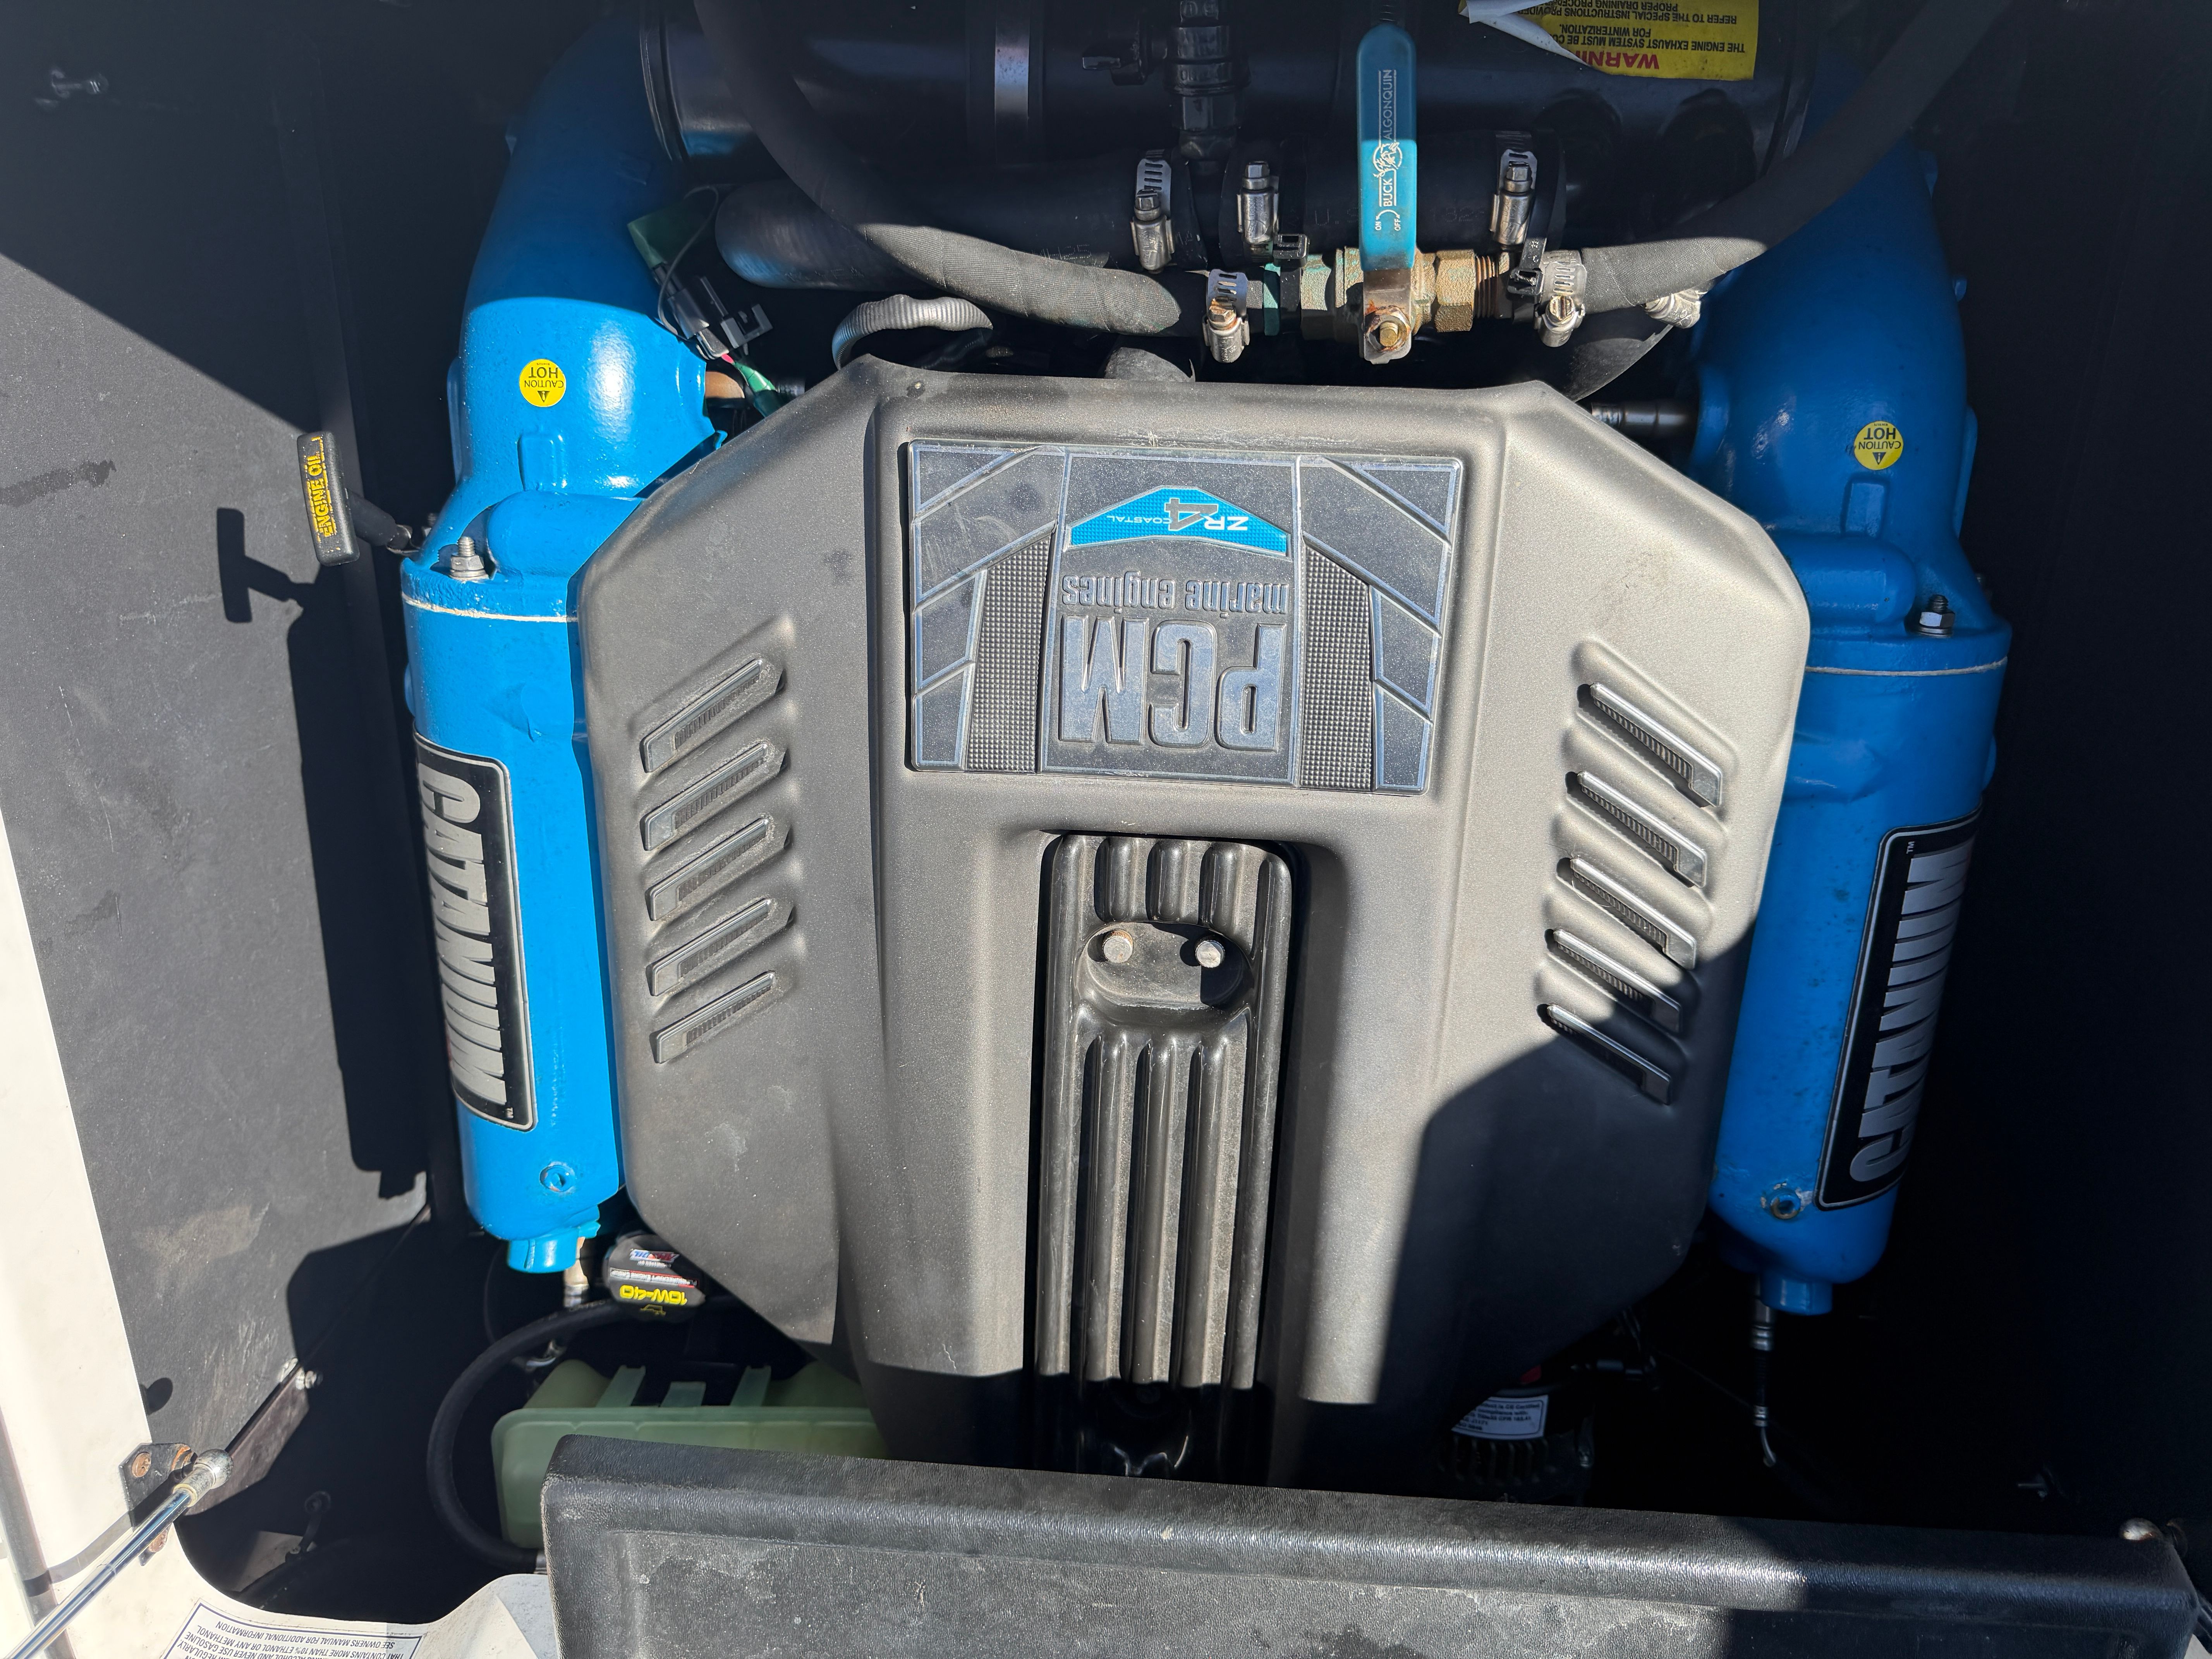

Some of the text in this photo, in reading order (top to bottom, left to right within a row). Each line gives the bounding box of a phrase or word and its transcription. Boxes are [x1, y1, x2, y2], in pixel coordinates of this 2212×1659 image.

[1595, 0, 1638, 10] DRAINING
[1641, 2, 1678, 12] PROPER
[1564, 7, 1630, 19] INSTRUCTIONS
[1632, 10, 1670, 21] SPECIAL
[1672, 12, 1690, 22] THE
[1692, 14, 1704, 23] TO
[1707, 14, 1737, 24] REFER
[1559, 24, 1651, 38] FOR WINTERIZATION.
[1566, 34, 1579, 45] BE
[1581, 35, 1606, 46] MUST
[1609, 37, 1645, 48] SYSTEM
[1646, 38, 1688, 50] EXHAUST
[1691, 41, 1725, 52] ENGINE
[1727, 43, 1745, 53] THE
[1383, 69, 1393, 140] ALGONQUIN
[1383, 179, 1393, 207] BUCK
[1375, 221, 1382, 231] ON
[528, 366, 558, 378] HOT
[524, 380, 564, 388] CAUTION
[1863, 428, 1896, 440] HOT
[1858, 441, 1901, 450] CAUTION
[307, 454, 333, 536] ENGINE OIL
[1106, 514, 1173, 524] COASTAL
[1061, 571, 1290, 618] marine engines
[1057, 615, 1287, 752] PCM
[417, 761, 507, 1106] CATANIUM
[1849, 832, 1976, 1182] CATANIUM
[619, 1285, 688, 1306] 10W-40
[215, 1621, 264, 1639] INFORMATION
[196, 1625, 235, 1647] METHANOL
[265, 1633, 306, 1643] ADDITIONAL
[321, 1637, 350, 1646] MANUAL
[184, 1632, 219, 1652] GASOLINE
[234, 1641, 252, 1649] ANY
[350, 1640, 381, 1648] OWNERS
[218, 1646, 234, 1656] USE
[232, 1650, 257, 1659] NEVER
[263, 1644, 294, 1654] ETHANOL
[329, 1649, 350, 1658] MORE
[350, 1651, 386, 1659] CONTAINS
